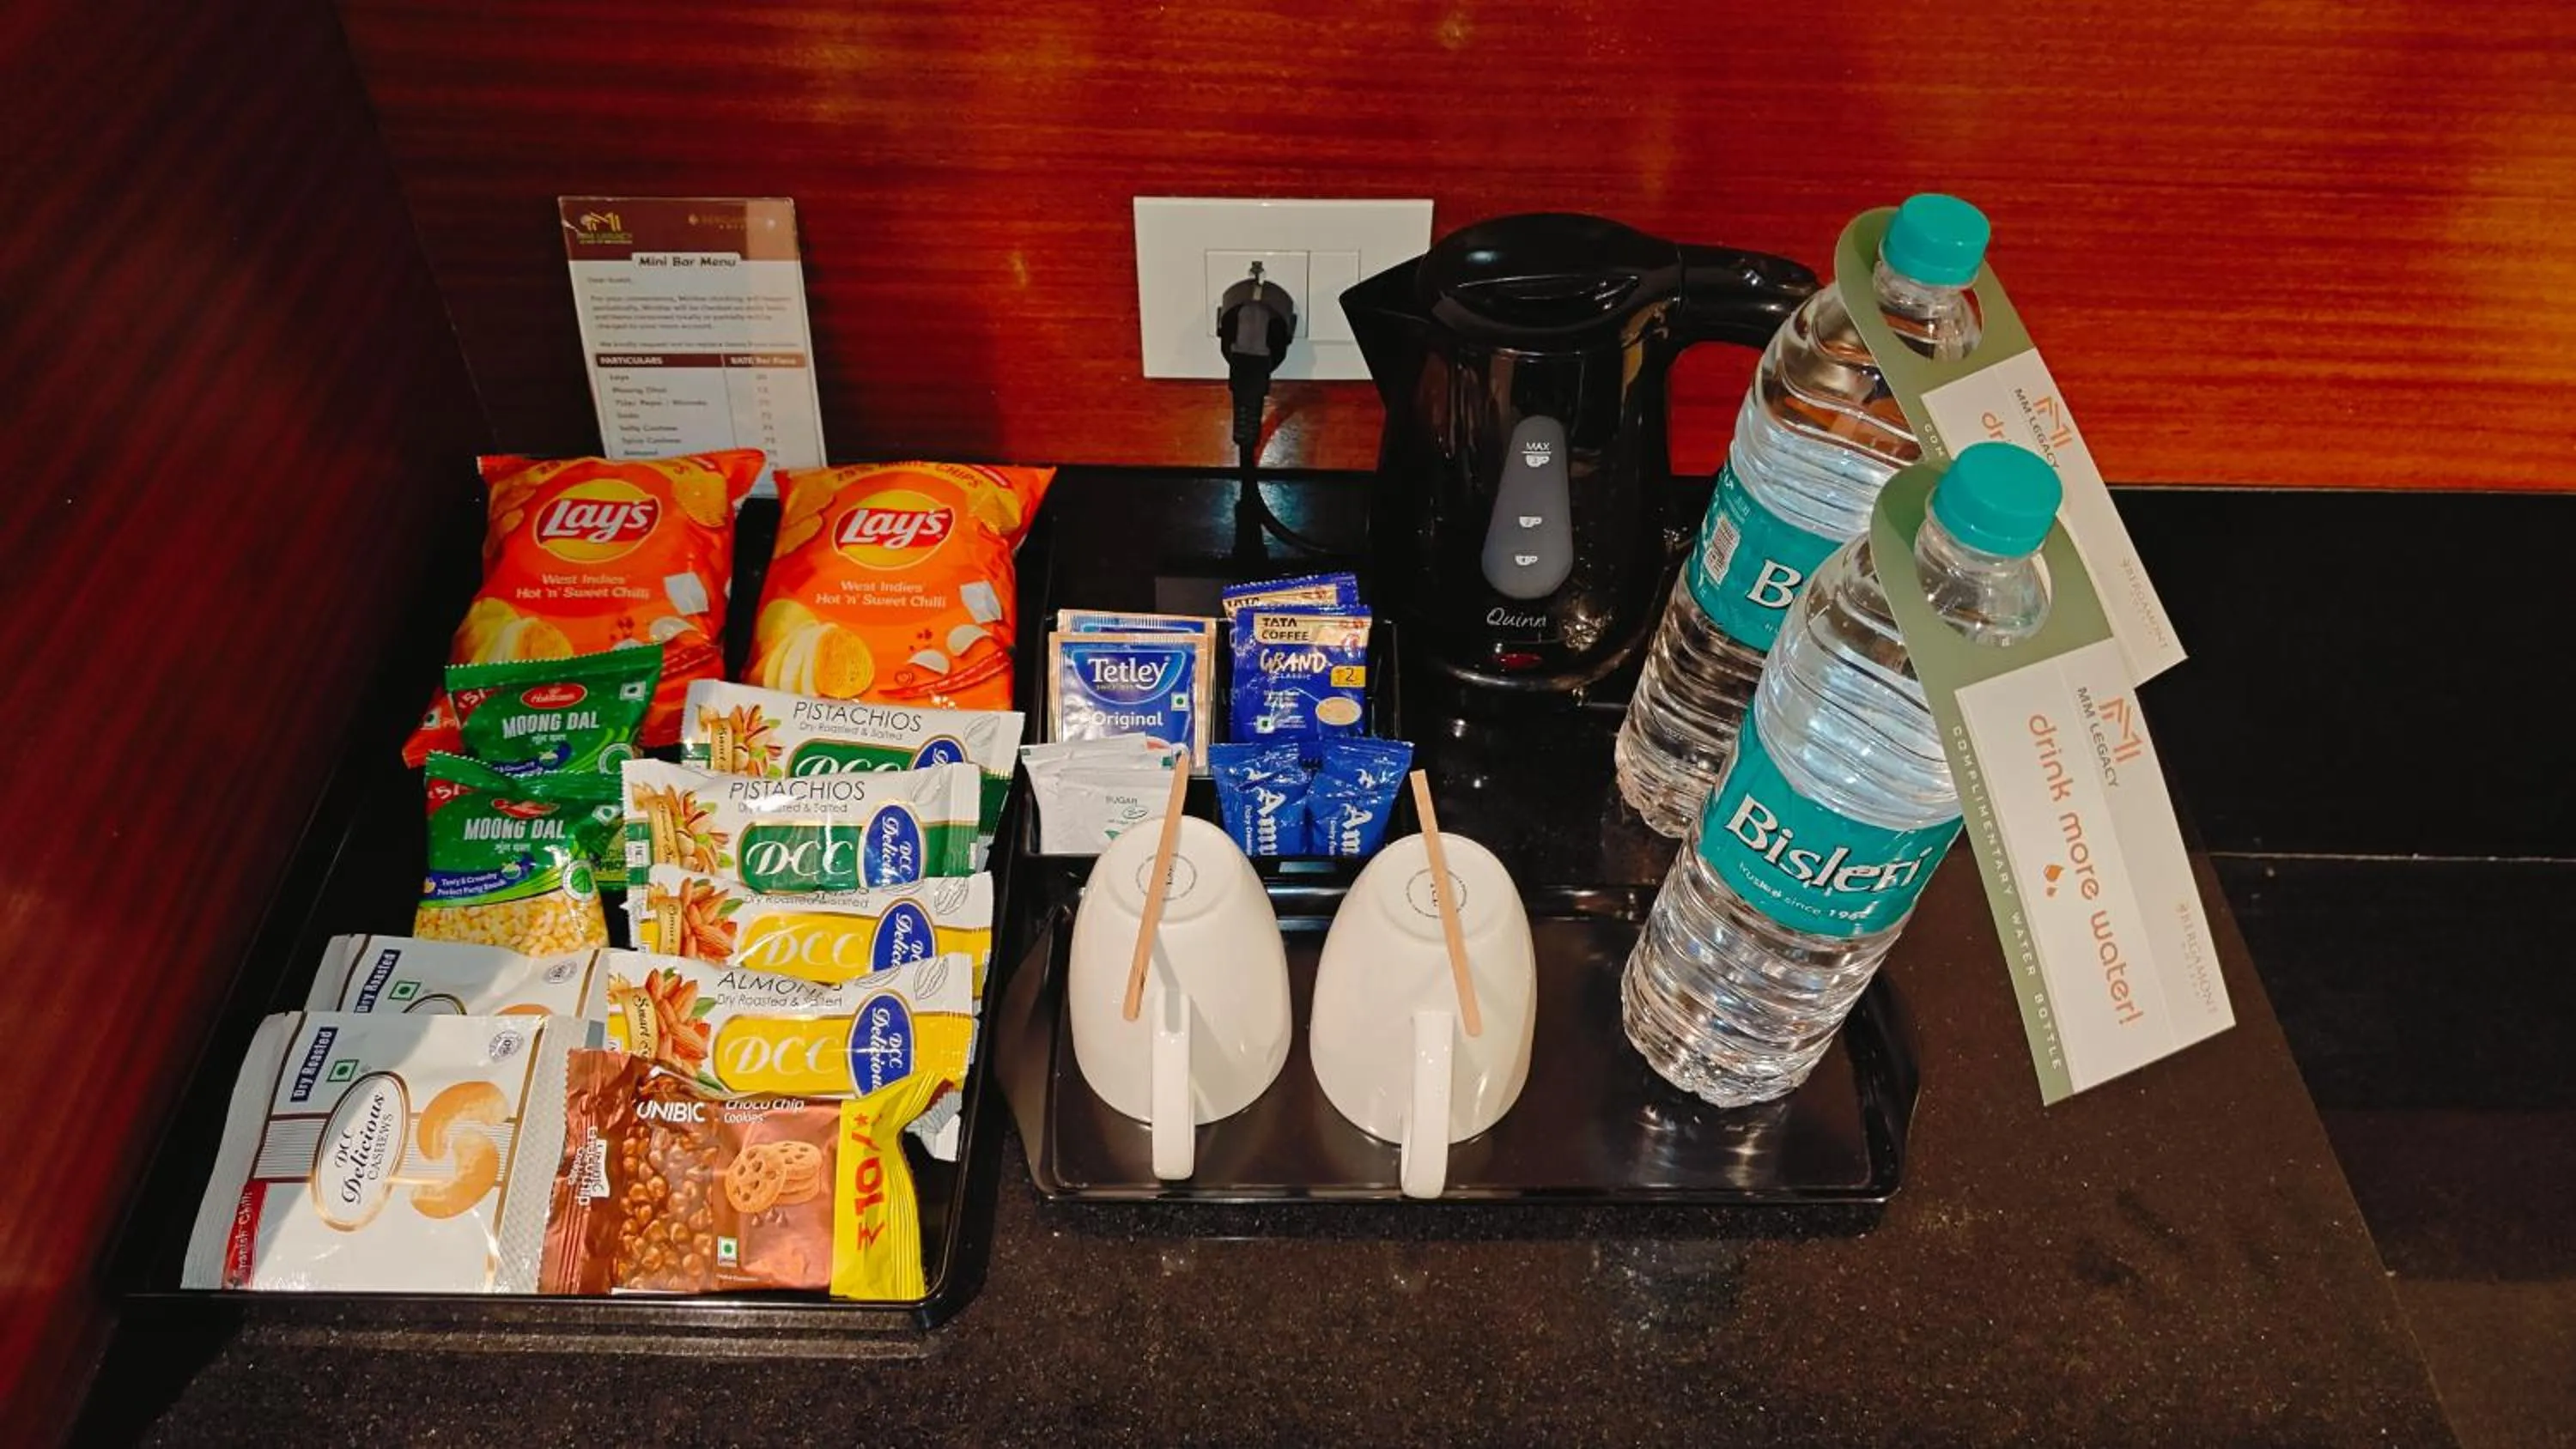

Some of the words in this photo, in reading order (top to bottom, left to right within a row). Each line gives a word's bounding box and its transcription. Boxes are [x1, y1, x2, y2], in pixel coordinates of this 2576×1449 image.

[638, 257, 667, 267] Mini
[671, 257, 696, 267] Bar
[700, 257, 736, 267] Menu
[599, 356, 664, 366] PARTICULARS
[2014, 388, 2032, 414] MM
[2029, 414, 2061, 468] LEGACY
[1525, 442, 1551, 452] MAX
[541, 499, 653, 543] Lay's
[838, 507, 949, 550] Lay's
[515, 587, 542, 599] Hot
[563, 585, 611, 599] Sweet
[611, 585, 651, 600] Chilli
[541, 573, 577, 585] West
[582, 573, 626, 585] Indies
[839, 580, 879, 593] West
[880, 580, 924, 594] Indies
[815, 592, 841, 605] Hot
[862, 593, 908, 607] Sweet
[909, 595, 948, 609] Chilli
[1261, 617, 1298, 627] TATA
[1486, 606, 1548, 628] Quinn
[1261, 629, 1309, 641] COFFEE
[1087, 656, 1170, 690] Tetley
[1259, 647, 1328, 674] GRAND
[501, 712, 562, 740] MOONG
[566, 710, 601, 731] DAL
[793, 700, 923, 733] PISTACHIOS
[1091, 711, 1164, 730] Original
[2076, 686, 2097, 718] MM
[2089, 722, 2120, 789] LEGACY
[728, 779, 866, 802] PISTACHIOS
[464, 817, 526, 841] MOONG
[530, 819, 567, 840] DAL
[1251, 785, 1287, 856] Amu
[744, 839, 854, 876] DCC
[1723, 792, 1934, 893] Bisleri
[2028, 713, 2075, 803] drink
[2058, 811, 2100, 901] more
[2090, 909, 2145, 1026] water!
[1951, 725, 2015, 897] COMPLIMENTARY
[2009, 911, 2038, 978] WATER
[2032, 992, 2063, 1072] BOTTLE
[753, 929, 865, 970] DCC
[356, 993, 374, 1014] Dry
[365, 952, 397, 993] Roasted
[715, 994, 736, 1009] Dry
[738, 994, 788, 1008] Roasted
[790, 996, 800, 1008] &
[302, 1030, 334, 1074] Roasted
[724, 1035, 841, 1075] DCC
[870, 1006, 891, 1090] Deliciou
[885, 1032, 903, 1070] DCC
[293, 1076, 313, 1100] Dry
[636, 1100, 707, 1123] UNIBIC
[724, 1112, 764, 1124] Cookies
[772, 1098, 805, 1112] Chip
[341, 1093, 386, 1205] Delicious
[367, 1113, 393, 1181] CASHEWS
